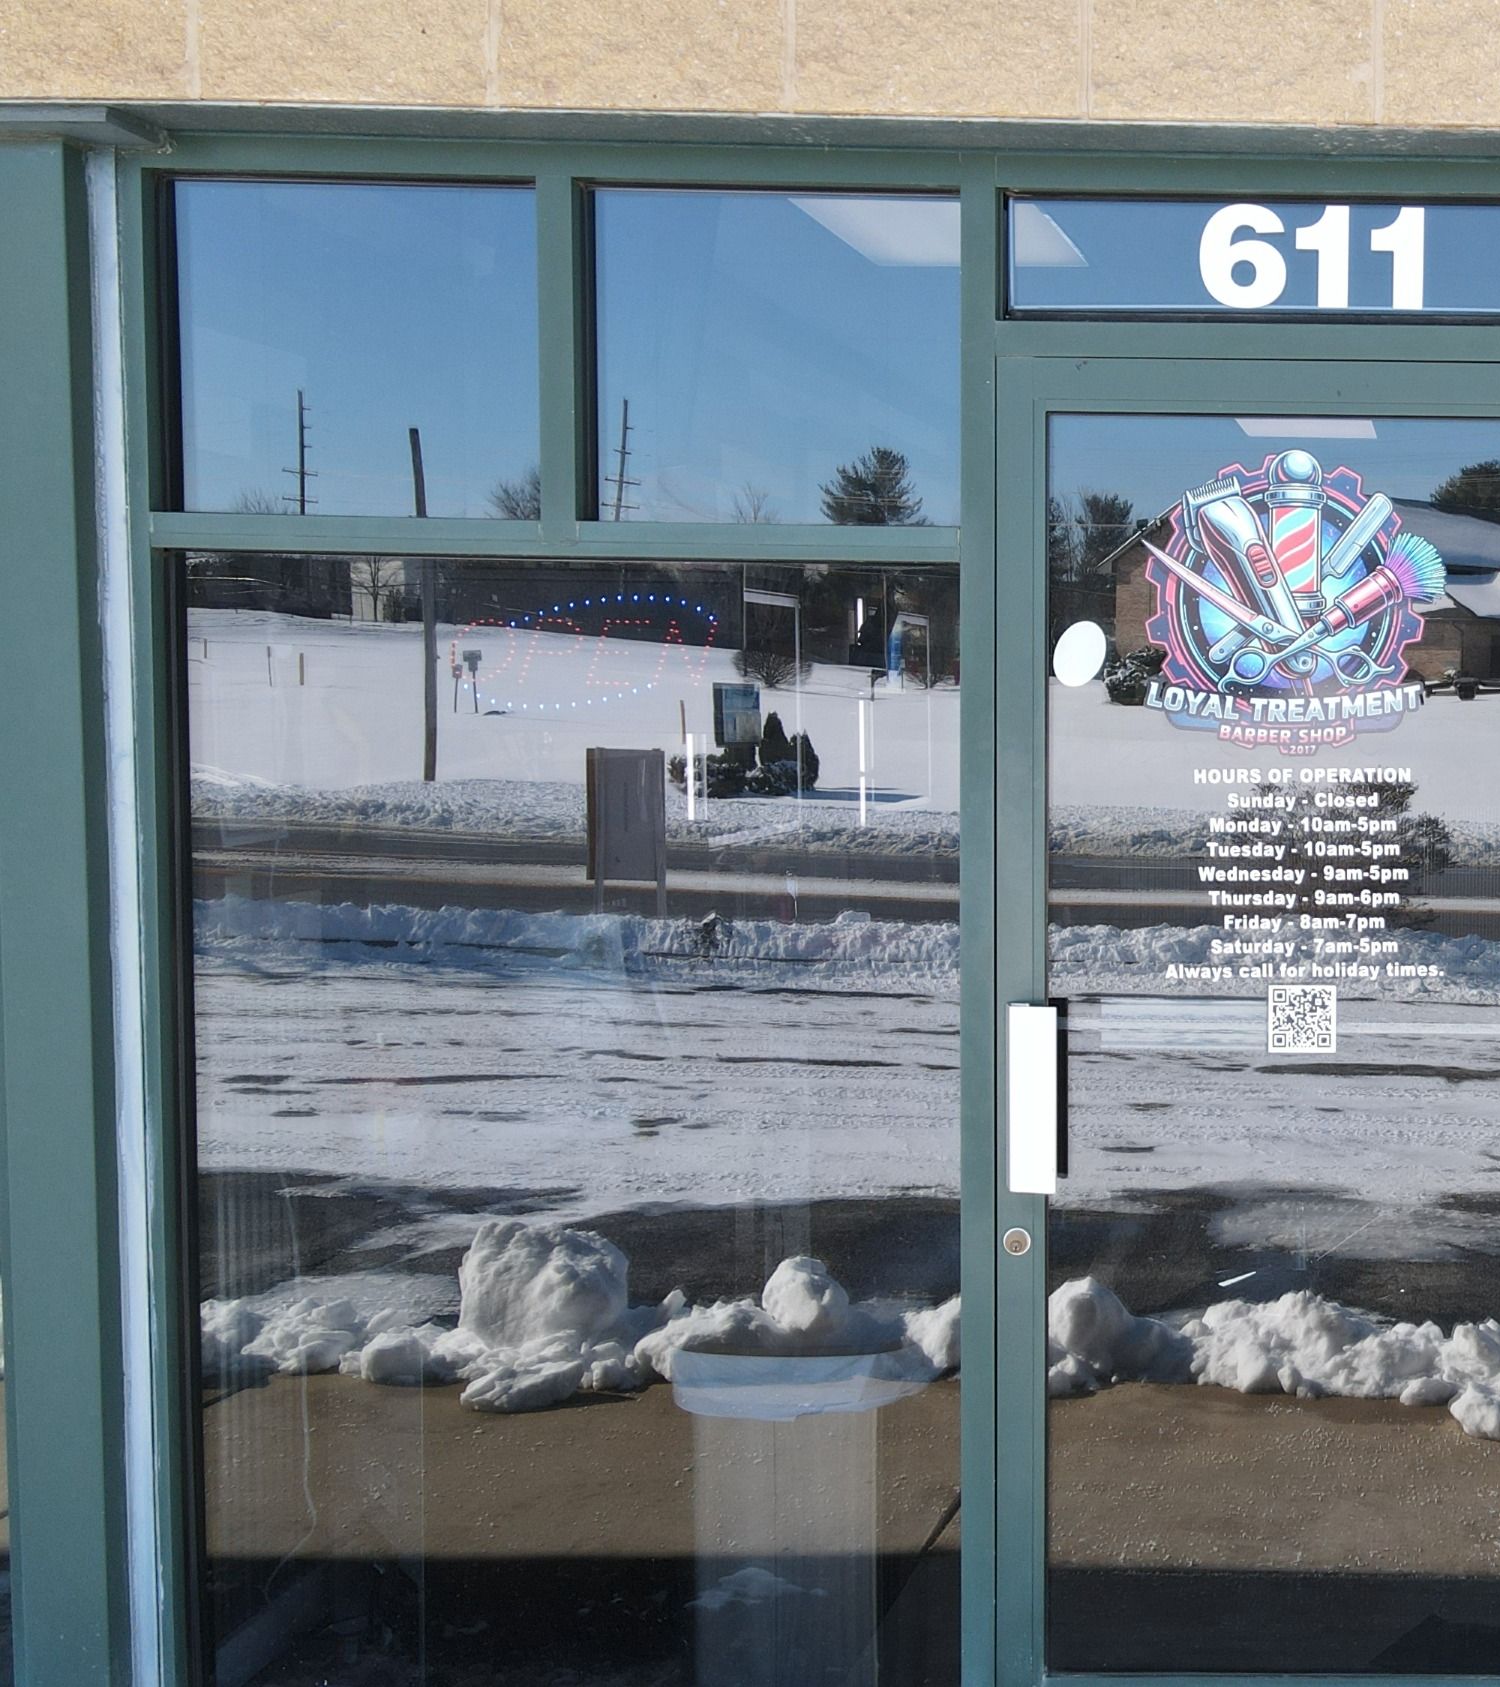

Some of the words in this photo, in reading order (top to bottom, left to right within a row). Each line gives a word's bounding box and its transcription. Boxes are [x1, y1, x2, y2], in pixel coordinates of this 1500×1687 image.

[1199, 203, 1425, 310] 611
[450, 618, 718, 687] OPEN
[1147, 682, 1240, 720] LOYAL
[1250, 684, 1422, 722] TREATMENT
[1219, 724, 1291, 744] BARBER
[1298, 726, 1347, 744] SHOP
[1289, 745, 1317, 755] 2017
[1193, 769, 1261, 784] HOURS
[1268, 769, 1293, 783] OF
[1299, 768, 1411, 783] OPERATION
[1227, 793, 1296, 811] Sunday
[1314, 793, 1379, 808] Closed
[1209, 818, 1282, 836] Monday
[1300, 817, 1397, 835] 10am-5pm
[1206, 842, 1285, 860] Tuesday
[1304, 841, 1401, 859] 10am-5pm
[1198, 866, 1305, 884] Wednesday
[1323, 865, 1409, 883] 9am-5pm
[1208, 891, 1296, 909] Thursday
[1314, 890, 1400, 907] 9am-6pm
[1223, 915, 1281, 933] Friday
[1299, 914, 1385, 932] 8am-7pm
[1210, 939, 1295, 957] Saturday
[1313, 938, 1398, 956] 7am-5pm
[1165, 964, 1232, 981] Always
[1239, 963, 1273, 978] call
[1279, 963, 1306, 978] for
[1312, 963, 1380, 981] holiday
[1385, 963, 1445, 978] times.
